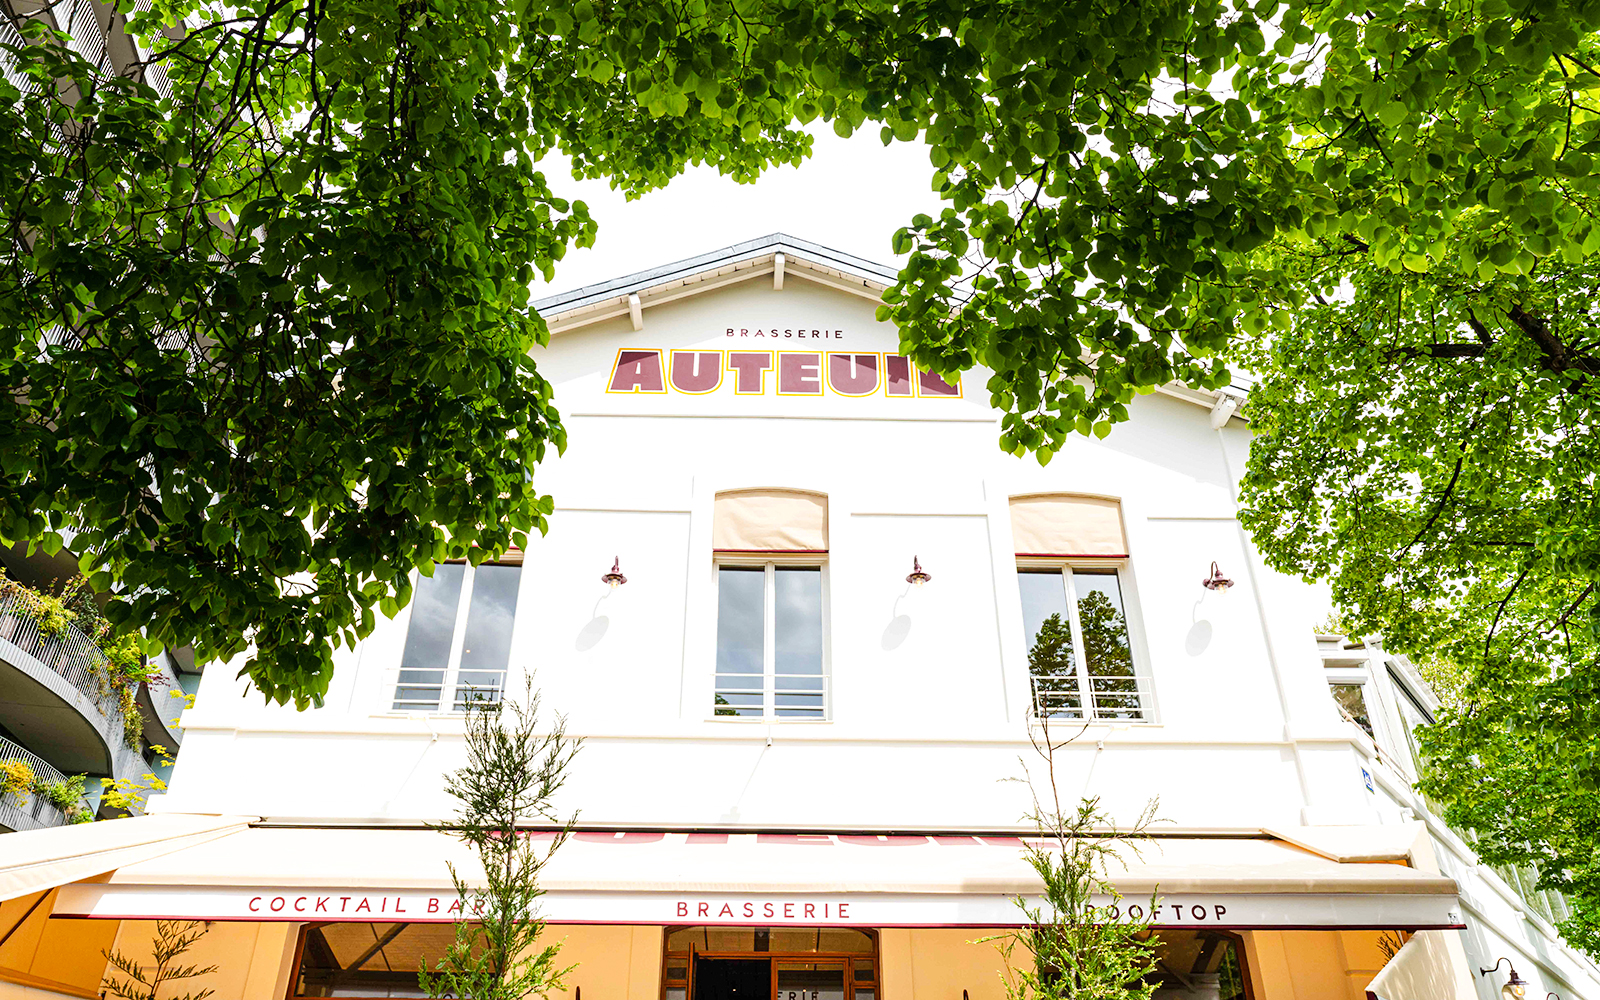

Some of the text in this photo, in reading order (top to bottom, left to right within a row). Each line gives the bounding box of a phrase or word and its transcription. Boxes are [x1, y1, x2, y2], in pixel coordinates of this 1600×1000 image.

[725, 328, 844, 339] BRASSERIE
[248, 896, 486, 914] COCKTAIL BAR
[676, 901, 850, 919] BRASSERIE
